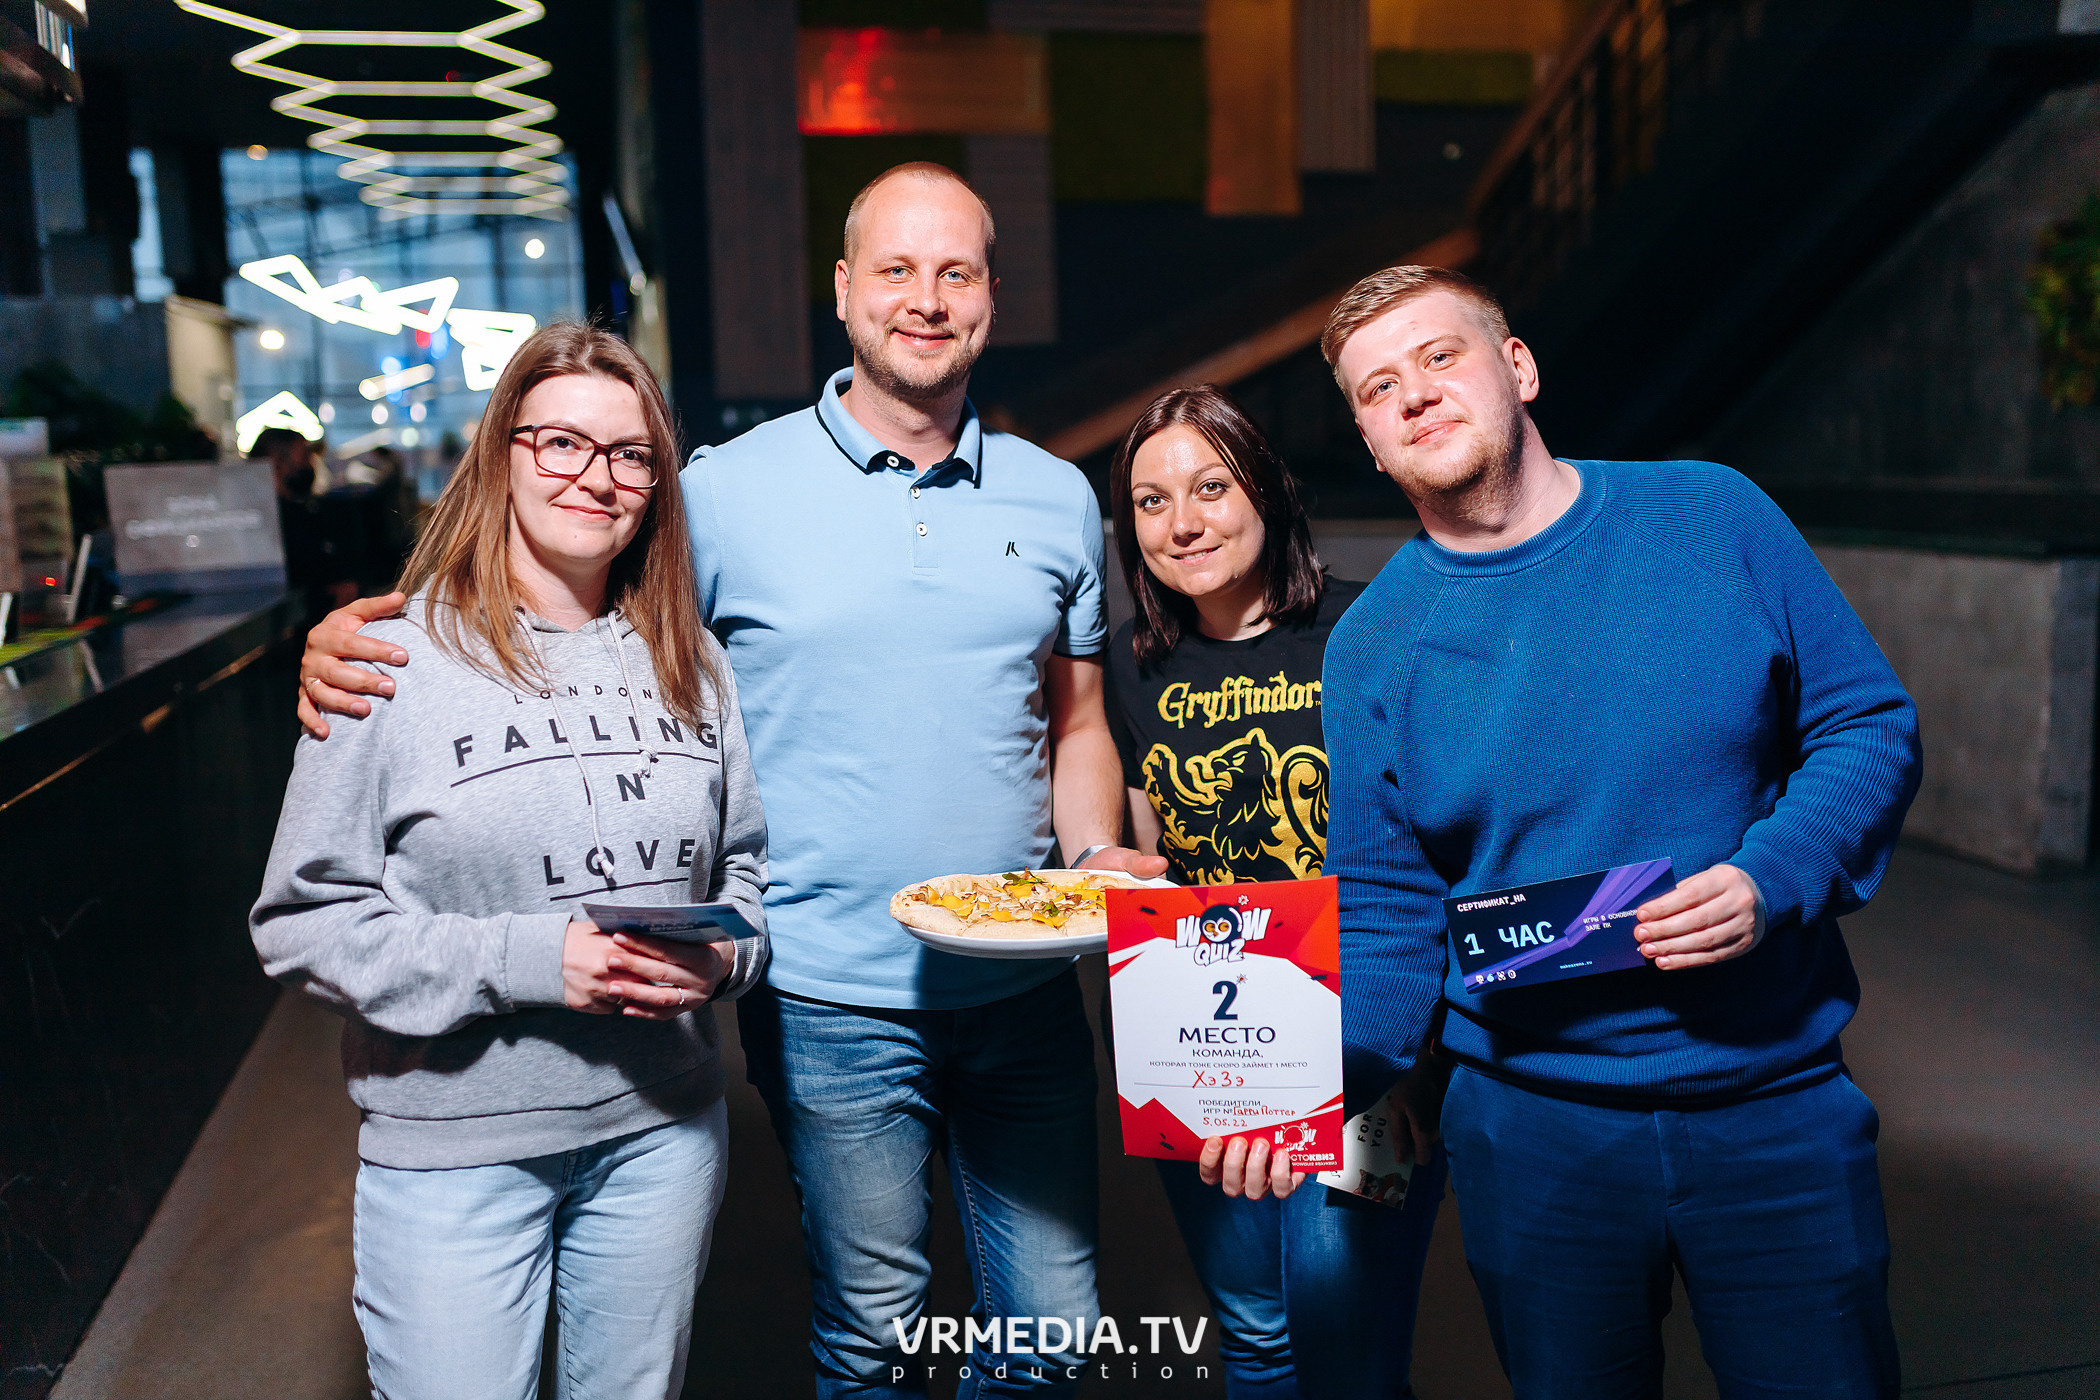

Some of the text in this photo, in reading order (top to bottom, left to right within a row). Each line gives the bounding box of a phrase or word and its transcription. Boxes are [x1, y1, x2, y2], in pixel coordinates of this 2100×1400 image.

[514, 685, 653, 704] LONDON
[1157, 670, 1322, 729] Gryffindor
[453, 714, 718, 768] FALLING
[583, 772, 646, 806] IN
[543, 838, 695, 886] LOVE
[1456, 893, 1526, 912] СЕРТИФИКАТ_НА
[1193, 939, 1246, 967] QUIZ
[1463, 920, 1555, 956] 1 ЧАС
[1212, 980, 1239, 1021] 2
[1178, 1026, 1276, 1044] МЕСТО
[1192, 1048, 1264, 1059] КОМАНДА,
[1198, 1099, 1261, 1107] ПОБЕДИТЕЛИ
[1357, 1113, 1373, 1143] FOR
[1370, 1117, 1387, 1147] YOU
